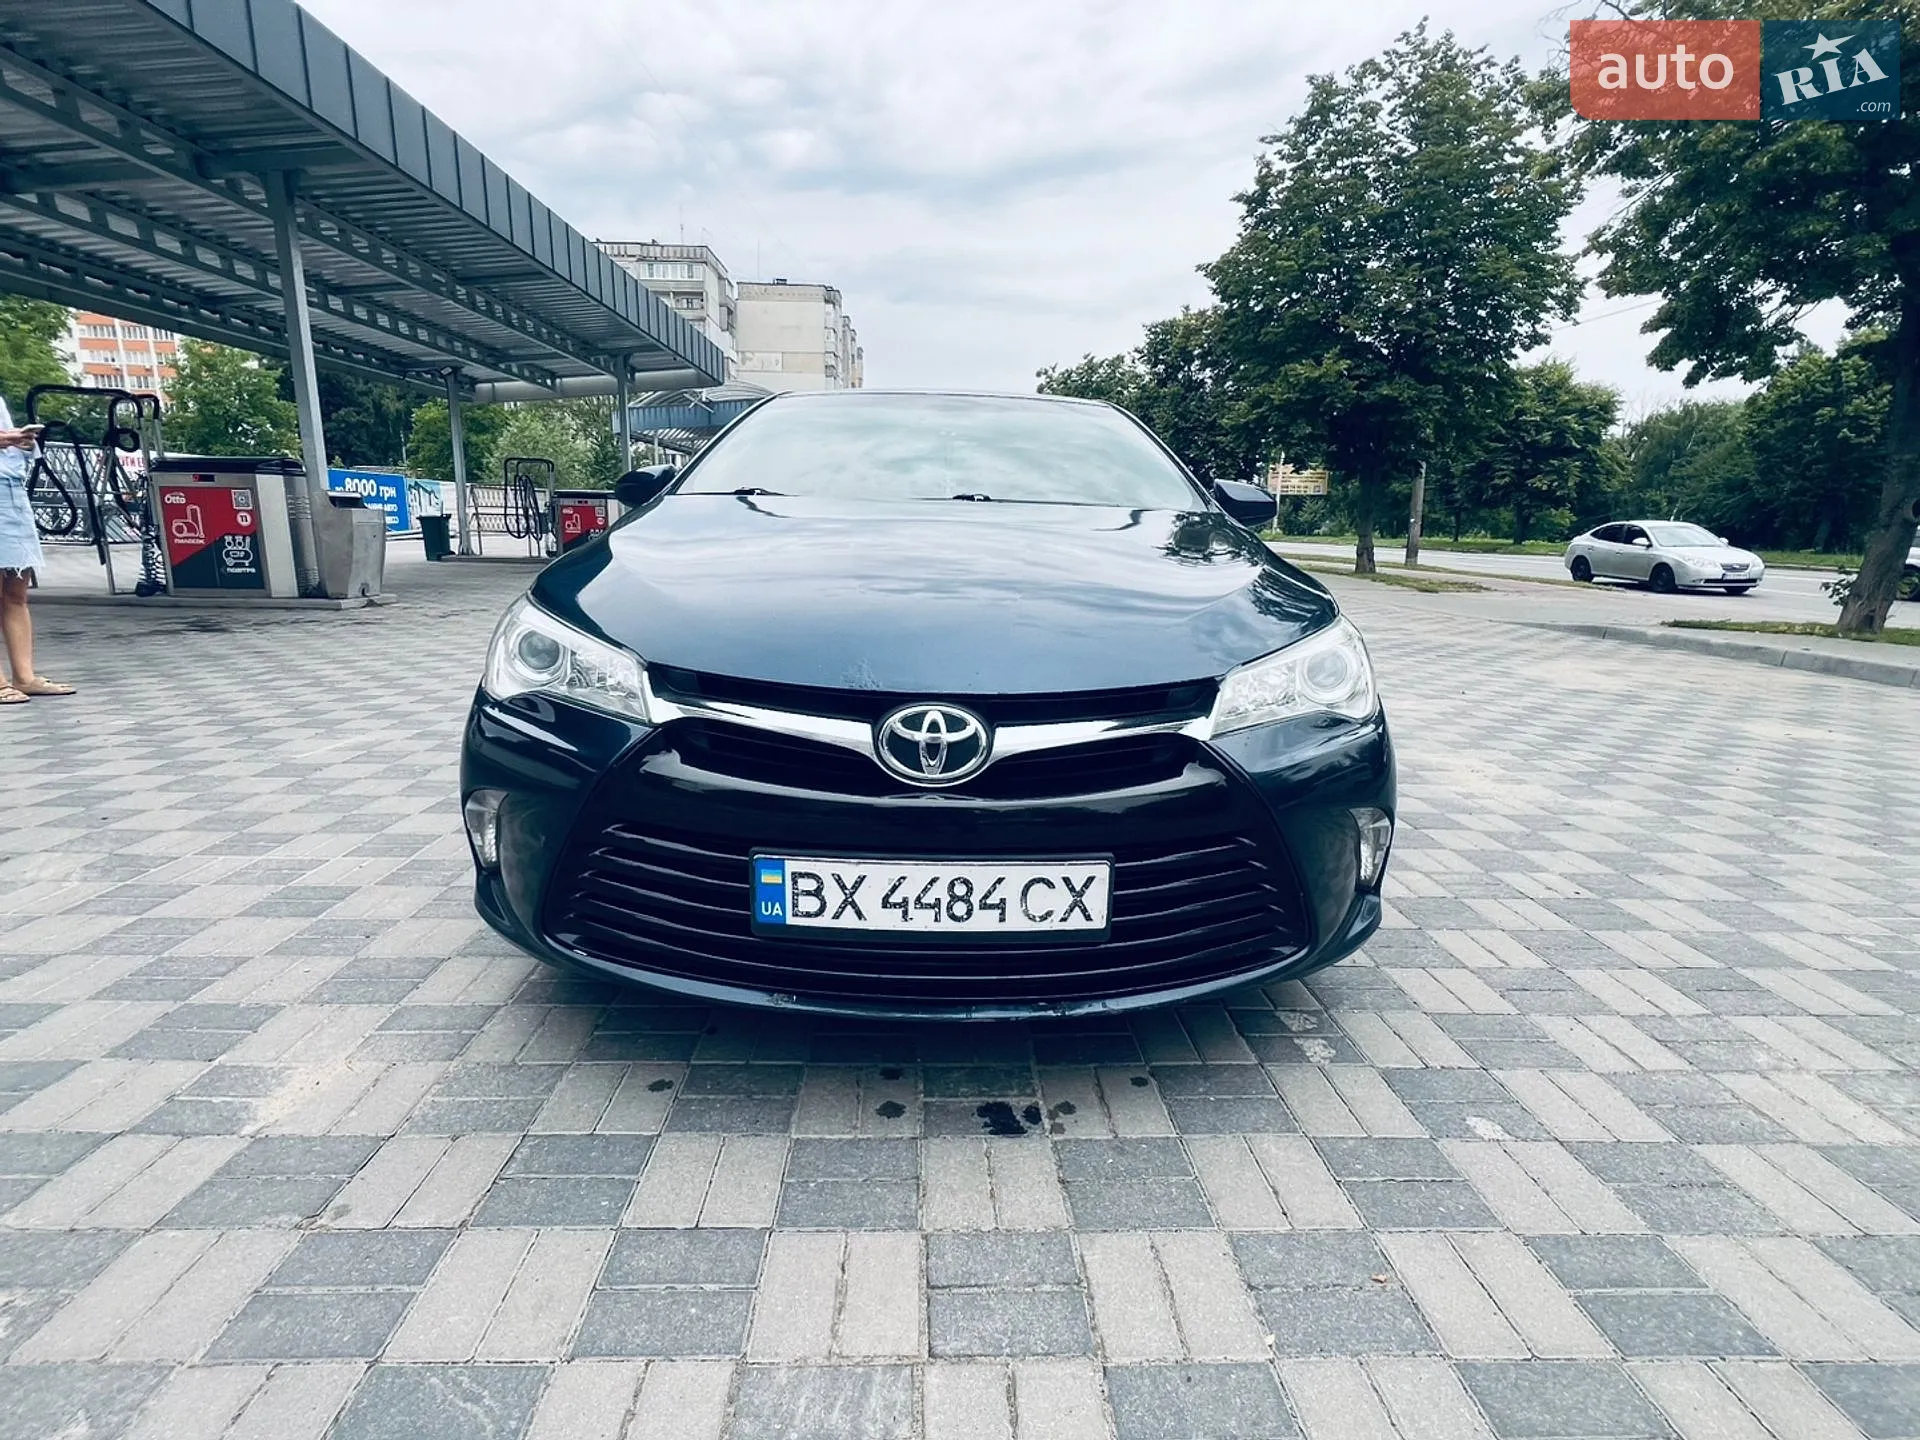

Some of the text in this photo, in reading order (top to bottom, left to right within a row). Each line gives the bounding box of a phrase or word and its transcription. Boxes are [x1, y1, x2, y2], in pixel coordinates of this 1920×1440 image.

[344, 477, 377, 497] 8000
[164, 493, 187, 504] Otto
[790, 871, 1097, 924] BX 4484 CX
[761, 901, 783, 917] UA
